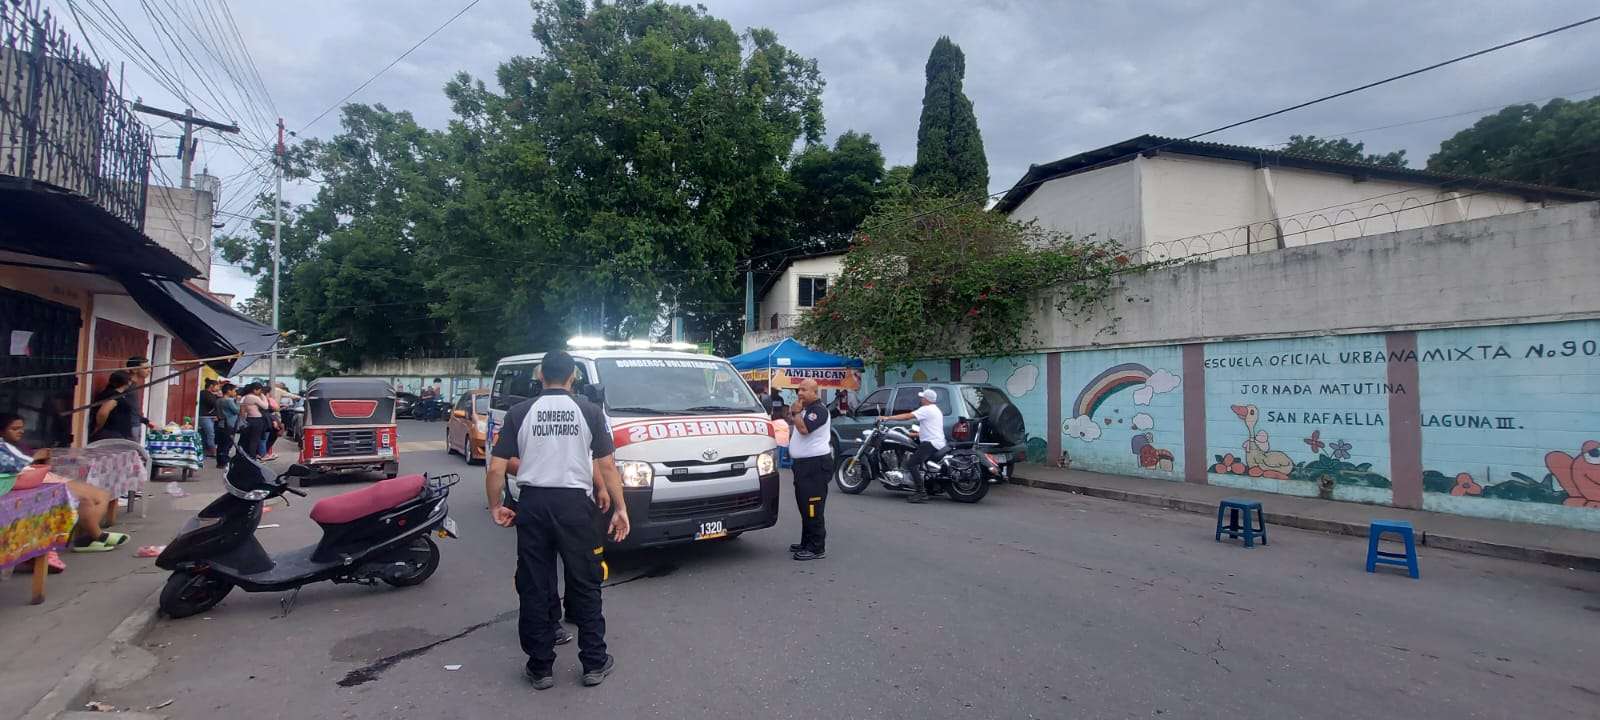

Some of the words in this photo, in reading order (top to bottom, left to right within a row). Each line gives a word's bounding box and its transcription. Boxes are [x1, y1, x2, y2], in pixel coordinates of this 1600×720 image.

[1204, 356, 1263, 369] ESCUELA
[1269, 352, 1332, 367] OFICIAL
[785, 368, 847, 379] AMERICAN
[1240, 383, 1313, 396] JORNADA
[1319, 382, 1406, 395] MATUTINA
[537, 410, 575, 422] BOMBEROS
[1266, 411, 1297, 424] SAN
[1420, 414, 1493, 429] LAGUNA
[531, 424, 580, 437] VOLUNTARIOS
[699, 520, 723, 535] 1320
